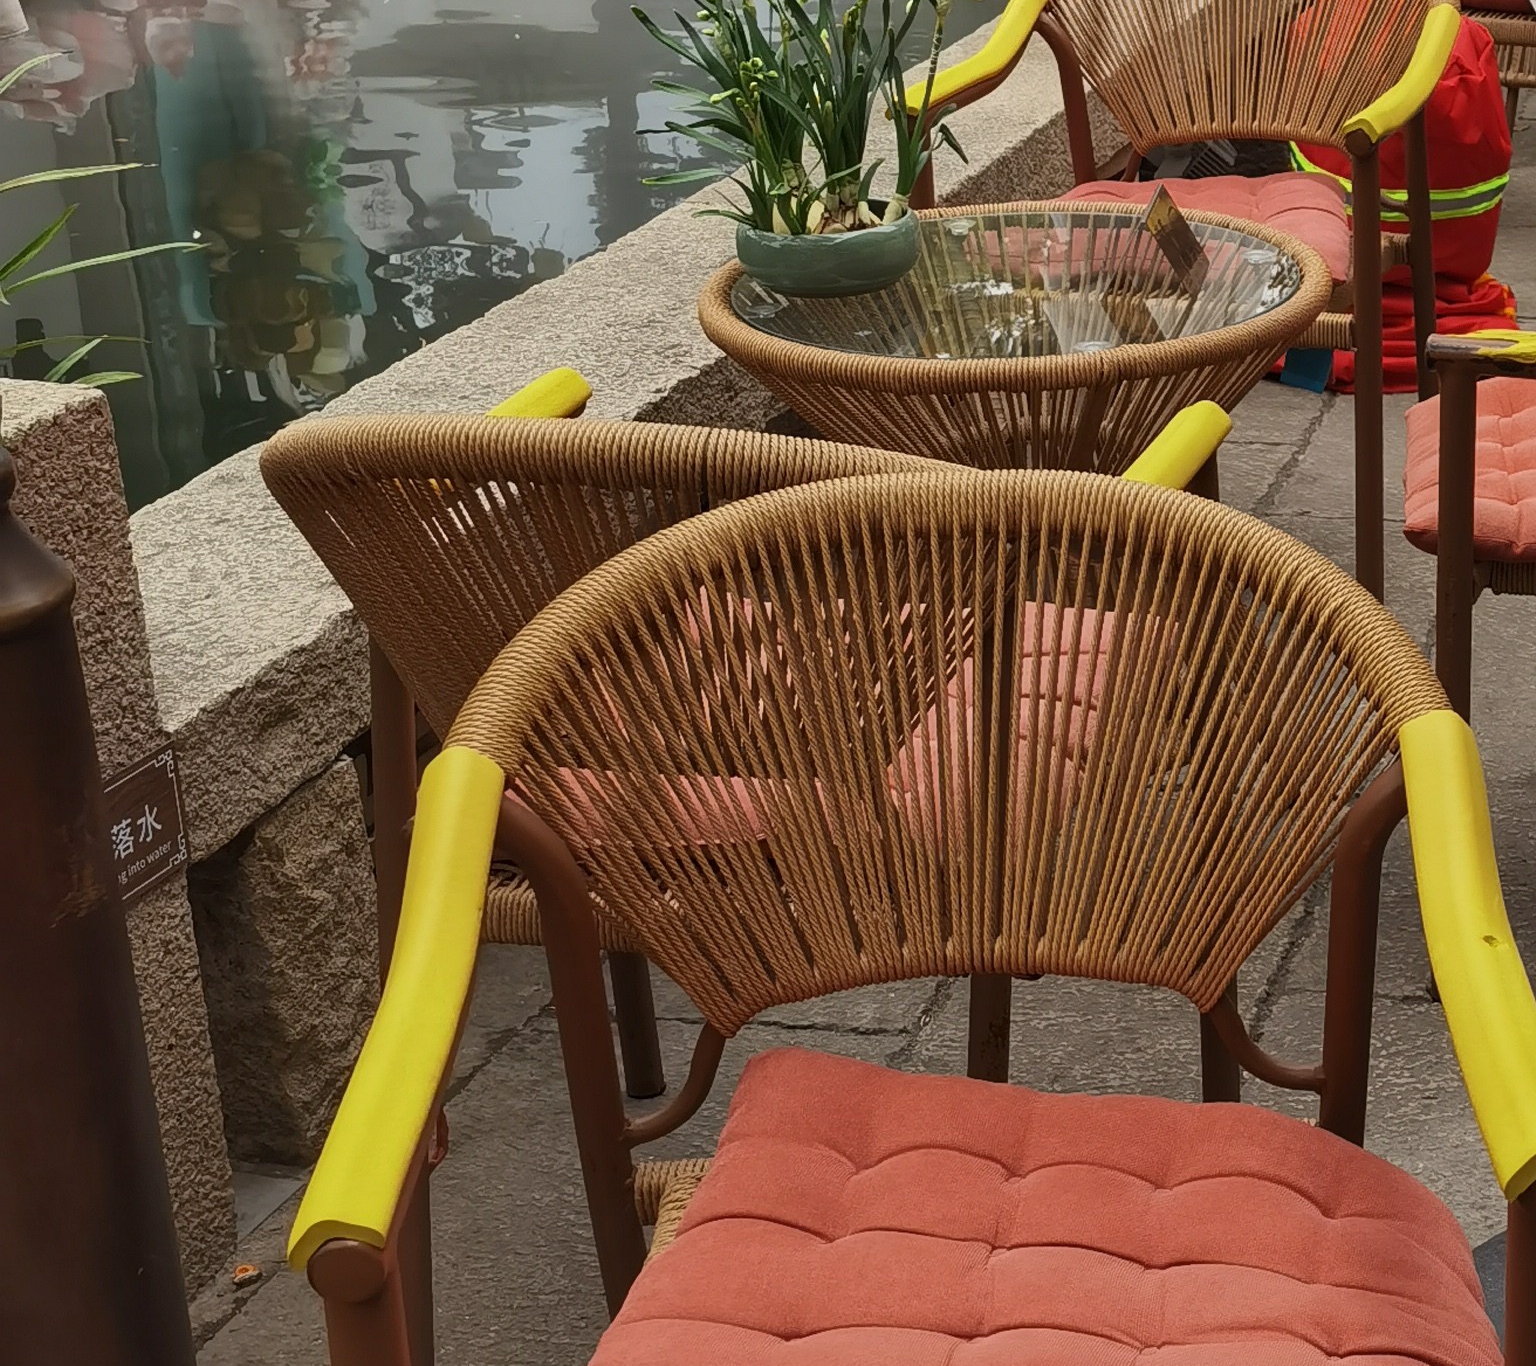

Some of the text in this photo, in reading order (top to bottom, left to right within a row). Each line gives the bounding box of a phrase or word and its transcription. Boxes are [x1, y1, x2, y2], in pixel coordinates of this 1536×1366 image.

[110, 803, 162, 860] 落水
[127, 857, 147, 878] into
[146, 839, 173, 865] water
